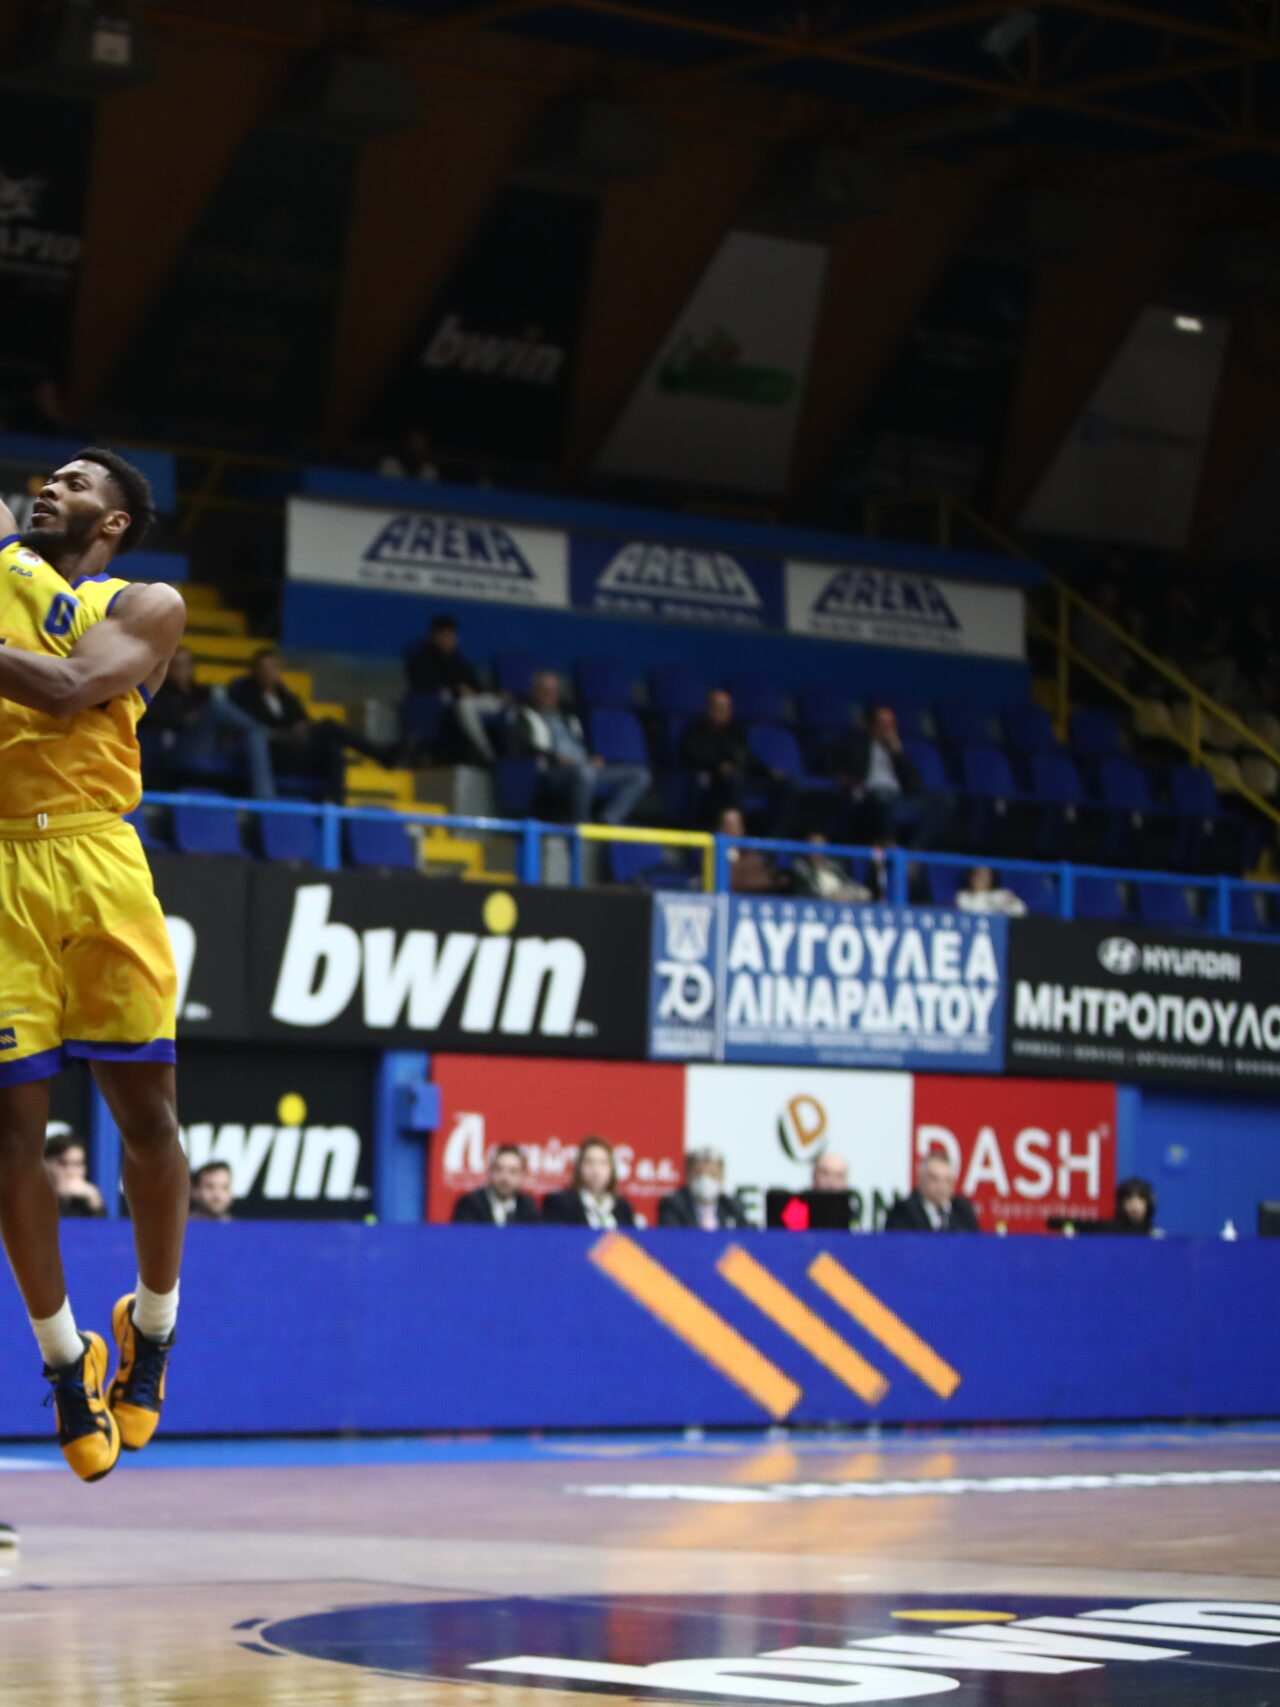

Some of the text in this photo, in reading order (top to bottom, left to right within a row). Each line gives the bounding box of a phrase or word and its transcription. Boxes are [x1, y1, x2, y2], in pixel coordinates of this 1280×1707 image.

[422, 312, 566, 383] bwin
[8, 565, 33, 578] FILA
[361, 514, 537, 580] ARENA
[597, 542, 762, 608] ARENA
[271, 883, 587, 1037] bwin
[728, 917, 1000, 983] ΑΥΓΟΥΛΕΑ
[1143, 945, 1242, 983] HYUNDAI
[726, 971, 999, 1037] ΛΙΝΑΡΔΑΤΟΥ
[179, 1092, 361, 1199] win
[915, 1125, 1103, 1200] DASH
